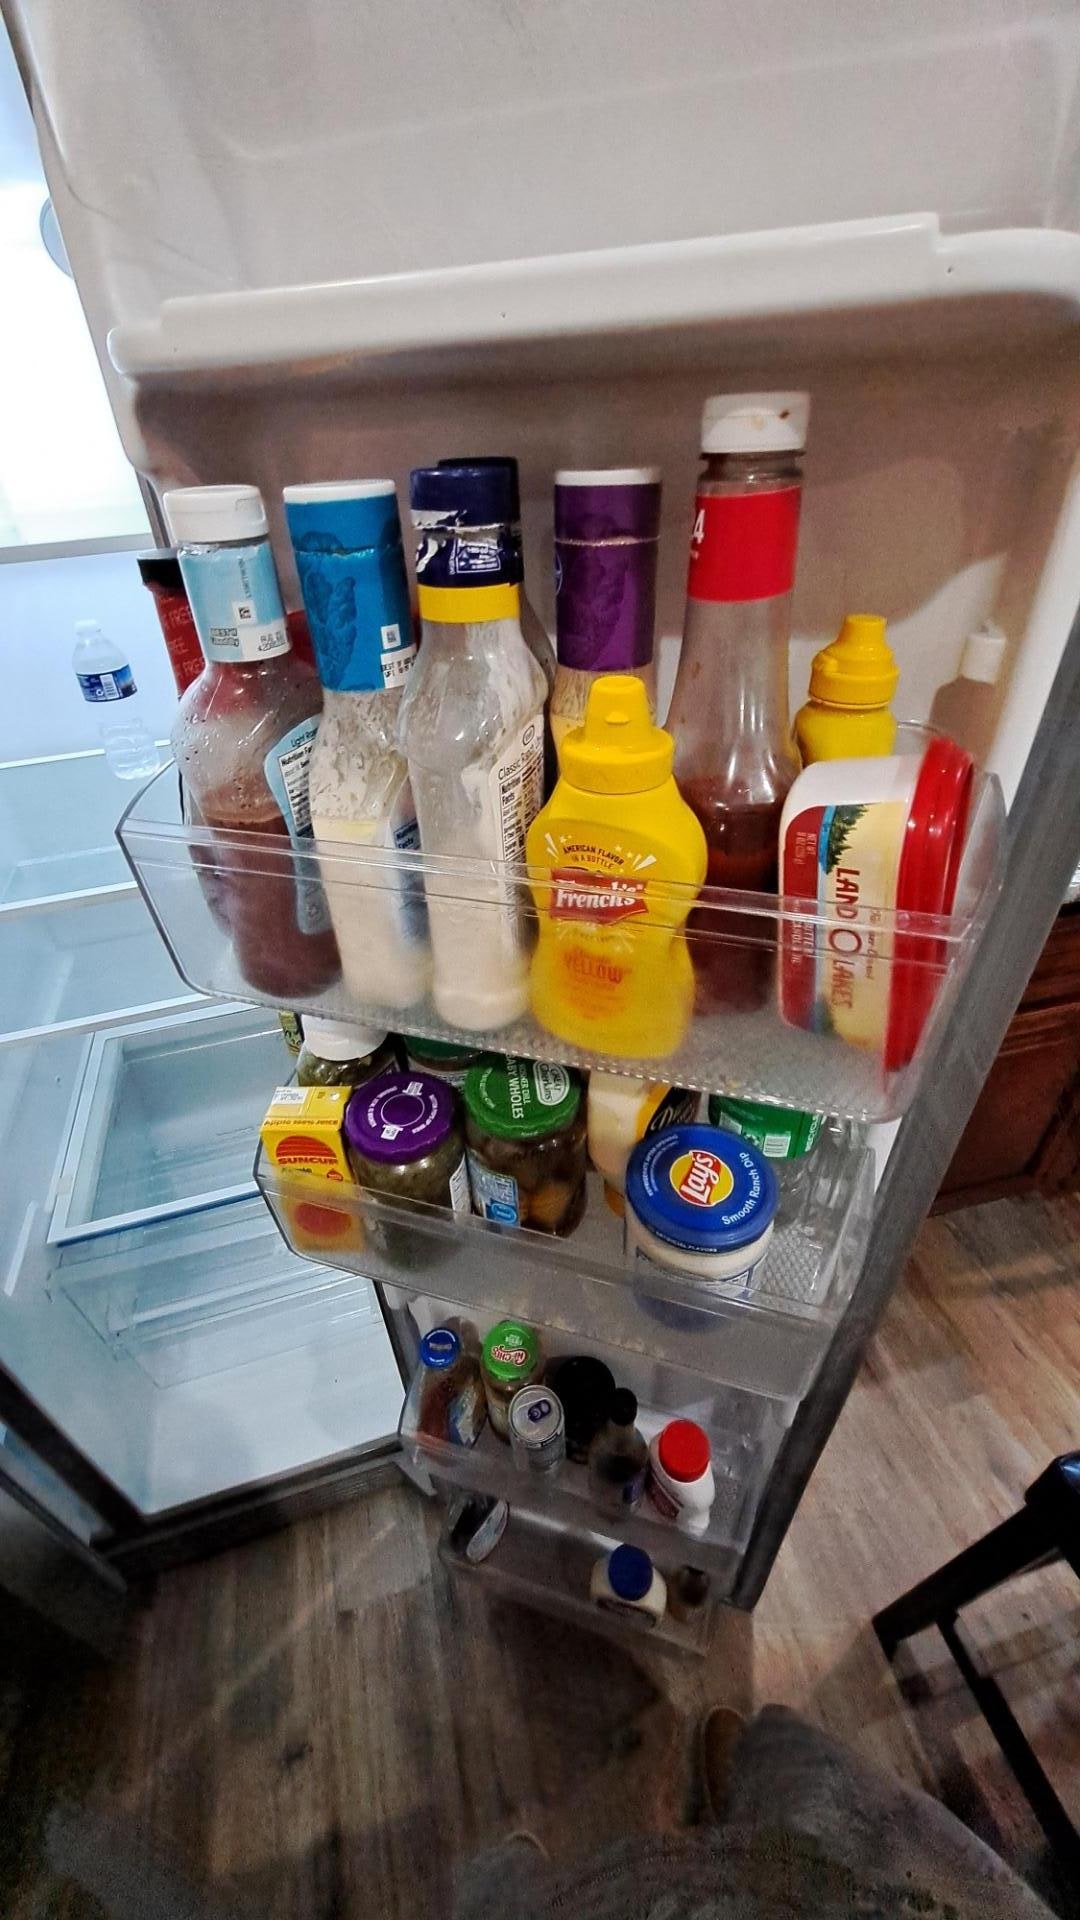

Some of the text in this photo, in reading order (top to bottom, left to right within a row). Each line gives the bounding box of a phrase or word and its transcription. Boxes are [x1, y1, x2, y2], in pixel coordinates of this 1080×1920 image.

[498, 759, 521, 781] Classic
[502, 791, 516, 805] Facts
[563, 844, 625, 866] AMERICAN FLAVOR
[585, 854, 614, 869] BOTTLE
[835, 867, 860, 920] LAND
[828, 927, 863, 955] O
[508, 1077, 525, 1119] WHOLES
[278, 1157, 339, 1166] SUNCUP
[680, 1152, 720, 1205] Lay's
[721, 1152, 762, 1225] Smooth Ranch Dip
